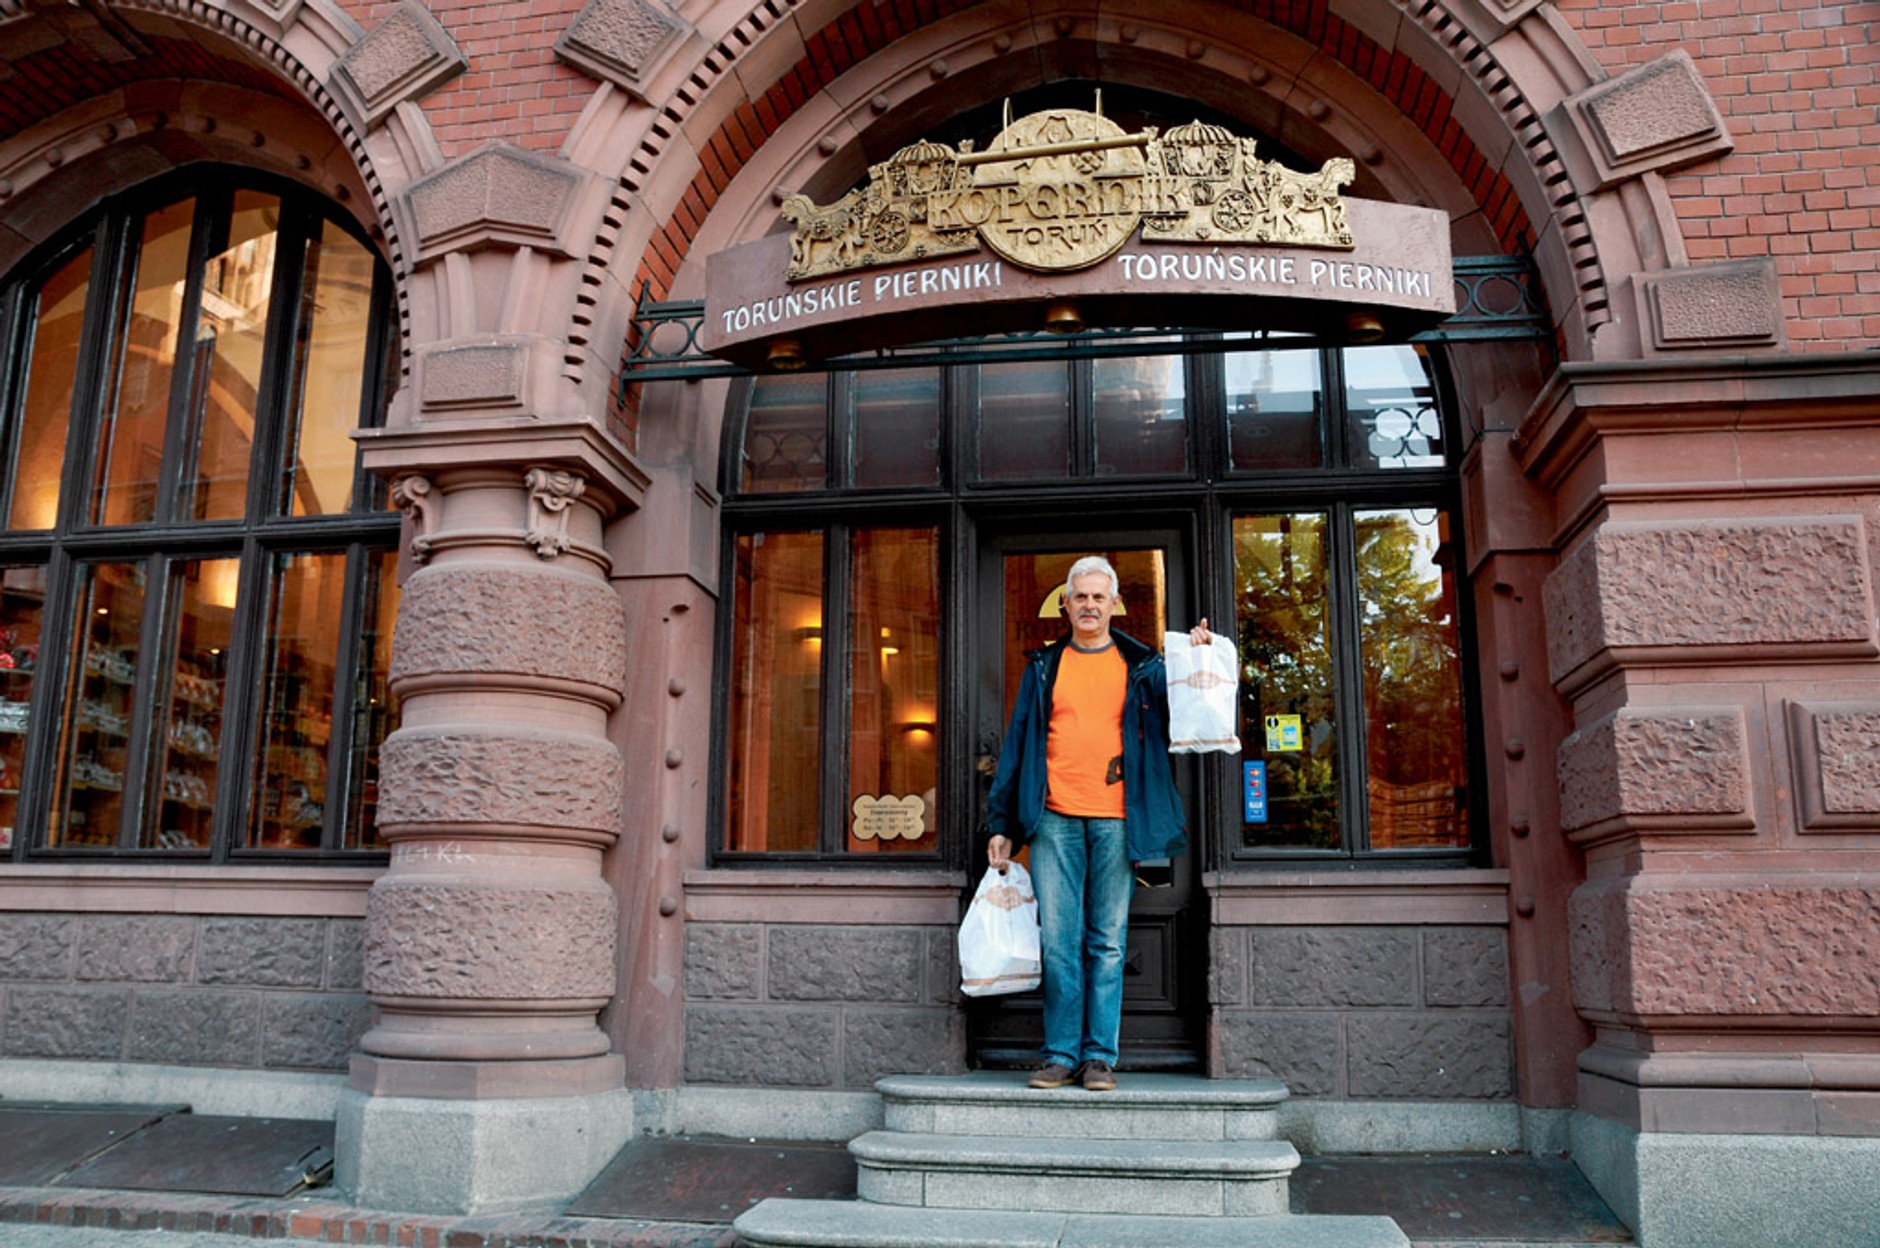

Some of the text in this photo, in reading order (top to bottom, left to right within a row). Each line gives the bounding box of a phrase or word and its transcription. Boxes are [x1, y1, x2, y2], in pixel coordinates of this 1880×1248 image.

[1006, 219, 1109, 250] TORUŃ
[874, 261, 1001, 300] PIERNIKI
[1117, 247, 1431, 297] TORUŃSKIE PIERNIKI
